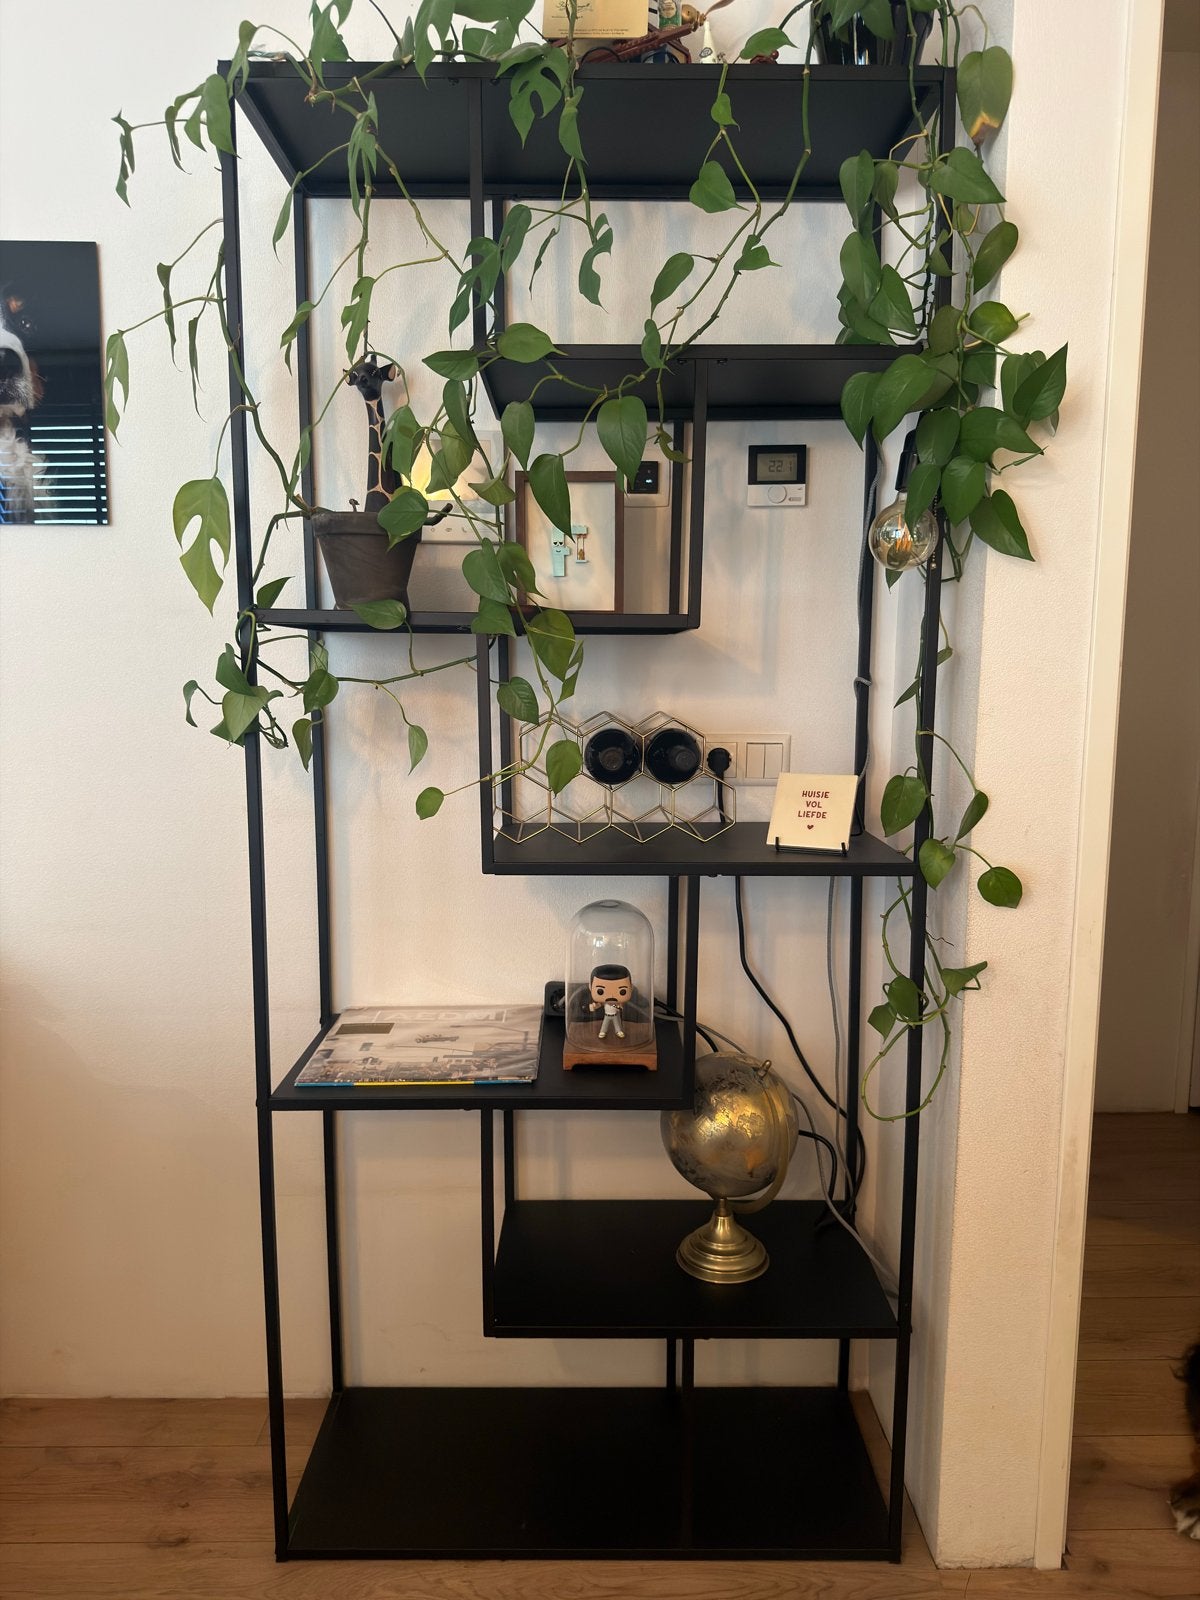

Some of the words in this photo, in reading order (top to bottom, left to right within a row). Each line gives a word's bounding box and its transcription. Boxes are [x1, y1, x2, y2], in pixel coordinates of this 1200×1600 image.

[801, 790, 830, 799] HUISJE
[805, 801, 823, 809] VOL
[797, 810, 828, 819] LIEFDE
